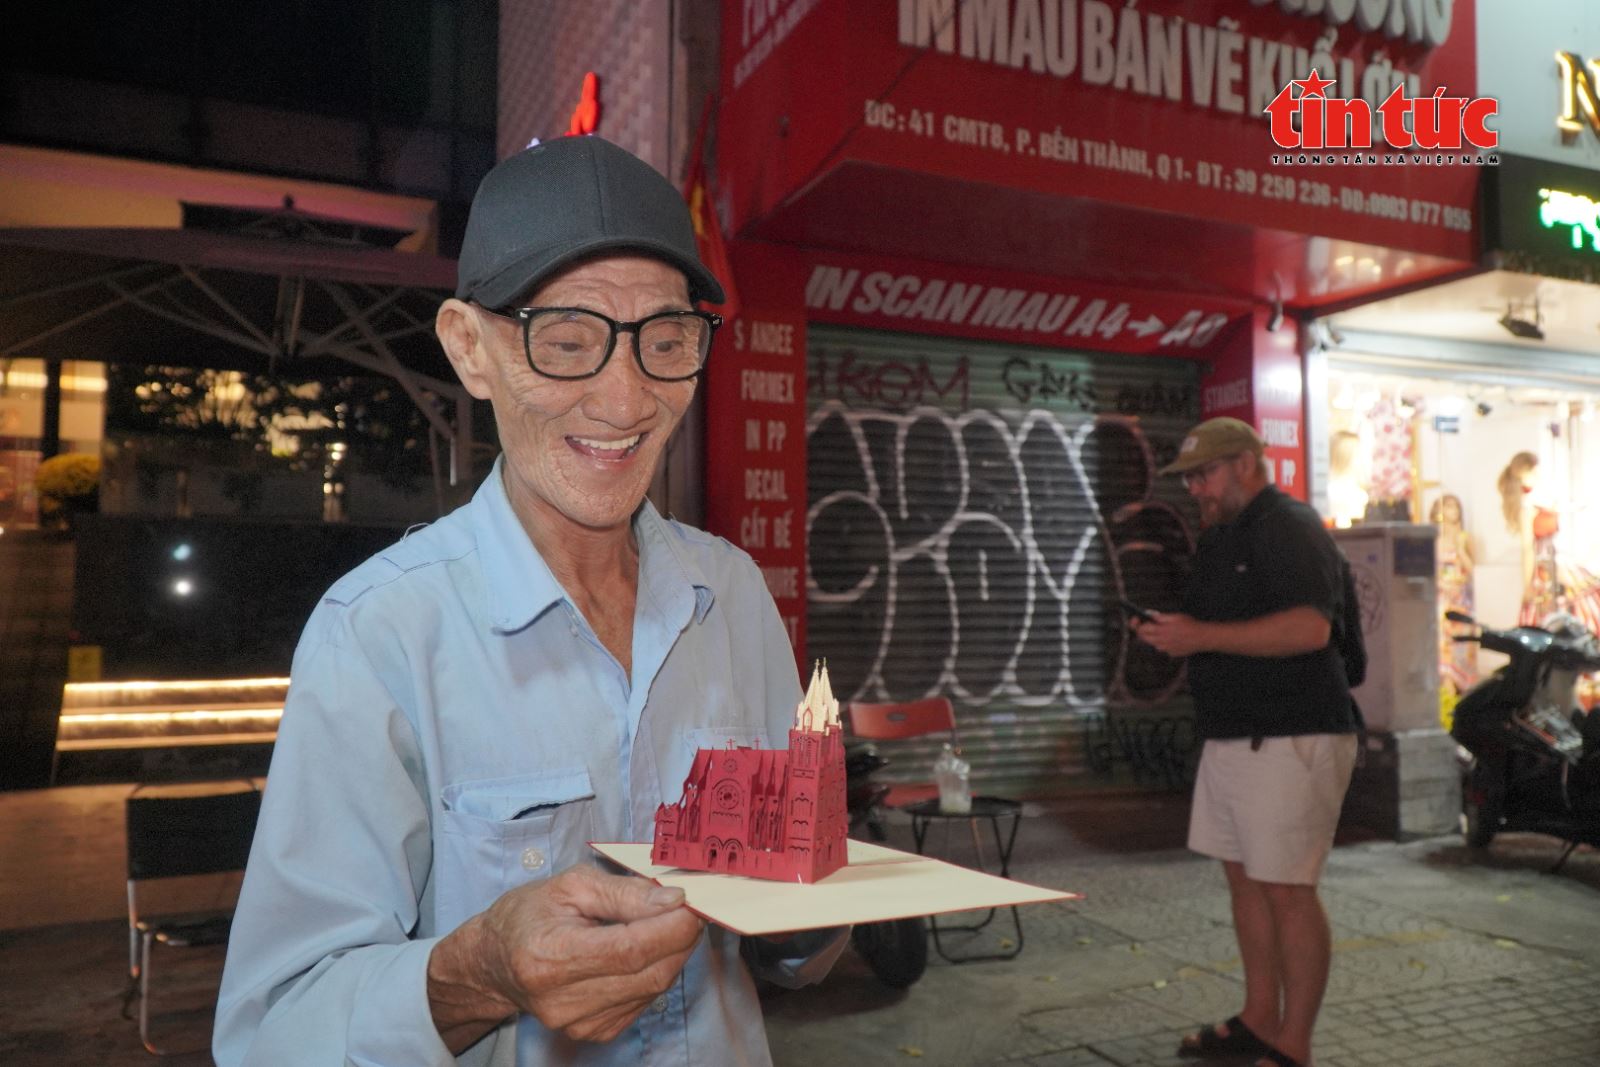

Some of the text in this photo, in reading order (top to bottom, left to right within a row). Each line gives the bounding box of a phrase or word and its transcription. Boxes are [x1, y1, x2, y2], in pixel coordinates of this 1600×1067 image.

[807, 265, 859, 310] IN
[853, 270, 981, 324] SCAN
[1064, 298, 1131, 341] A4
